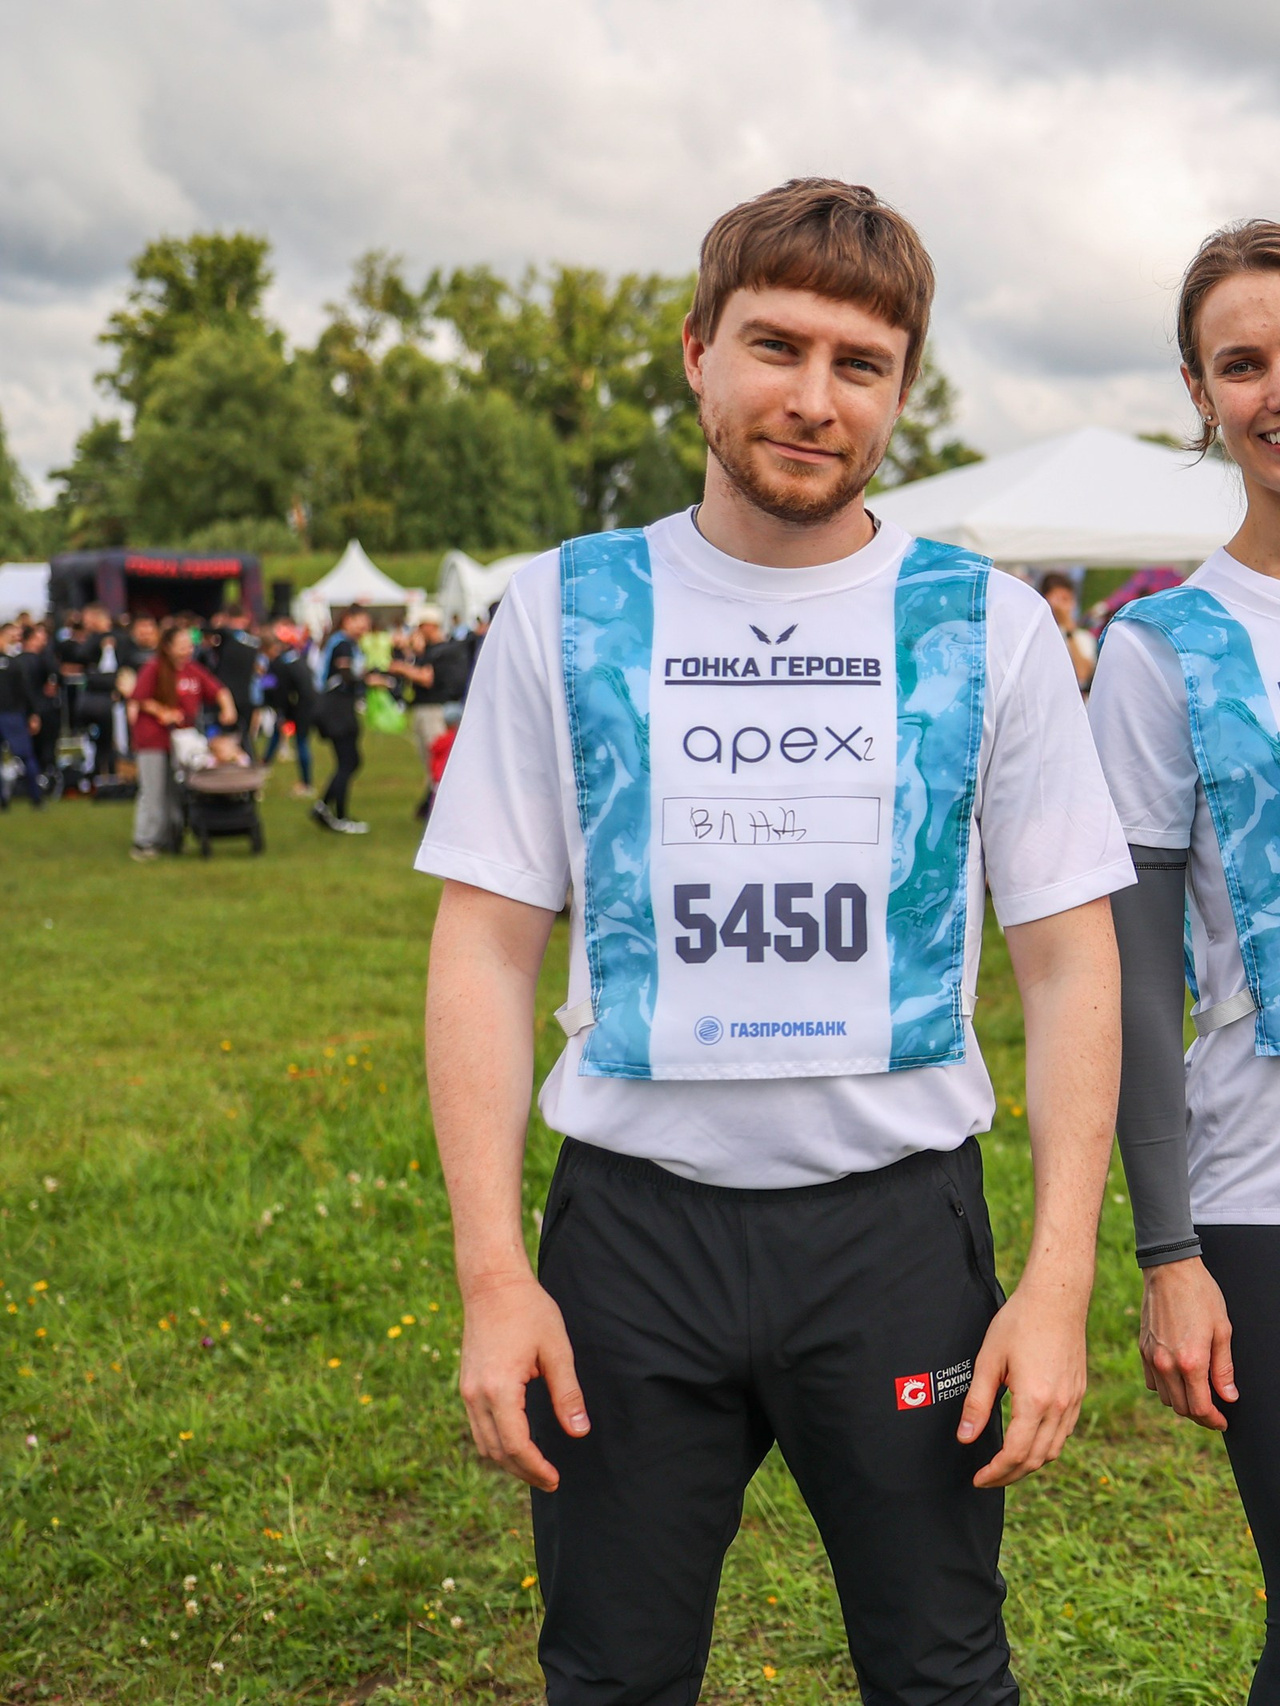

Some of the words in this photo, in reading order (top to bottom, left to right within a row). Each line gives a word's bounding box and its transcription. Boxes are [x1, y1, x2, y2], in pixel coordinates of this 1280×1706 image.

[665, 657, 760, 677] ГОНКА
[771, 656, 882, 677] ГЕРОЕВ
[674, 882, 868, 964] 5450
[730, 1020, 847, 1039] ГАЗПРОМБАНК
[936, 1359, 971, 1380] CHINESE
[937, 1370, 972, 1390] BOXING
[938, 1381, 972, 1402] FEDERA
